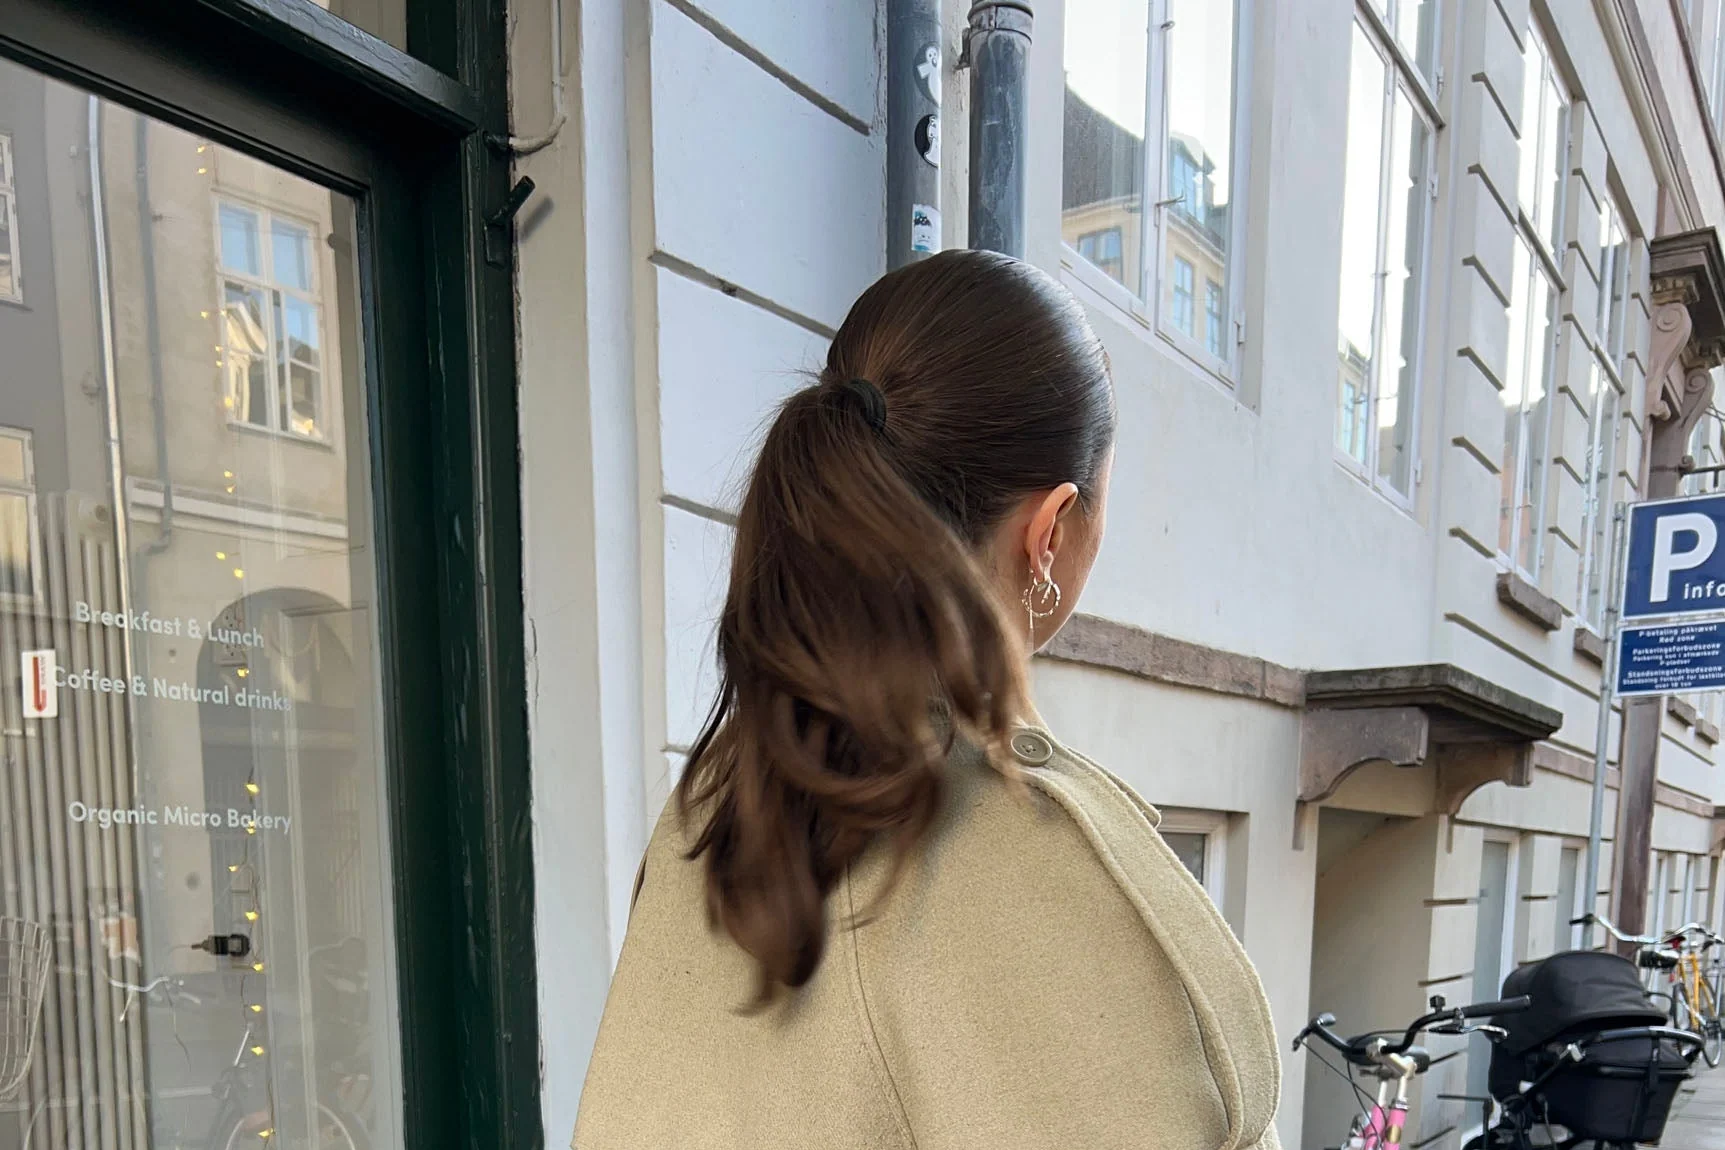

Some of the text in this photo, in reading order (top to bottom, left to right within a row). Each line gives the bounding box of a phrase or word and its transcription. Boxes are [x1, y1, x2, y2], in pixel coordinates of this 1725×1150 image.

[1650, 512, 1717, 602] P
[75, 601, 265, 648] Breakfast & Lunch
[54, 666, 126, 694] Coffee
[132, 676, 147, 696] &
[153, 677, 229, 706] Natural
[235, 688, 292, 712] drinks
[68, 801, 293, 835] Organic Micro Bakery
